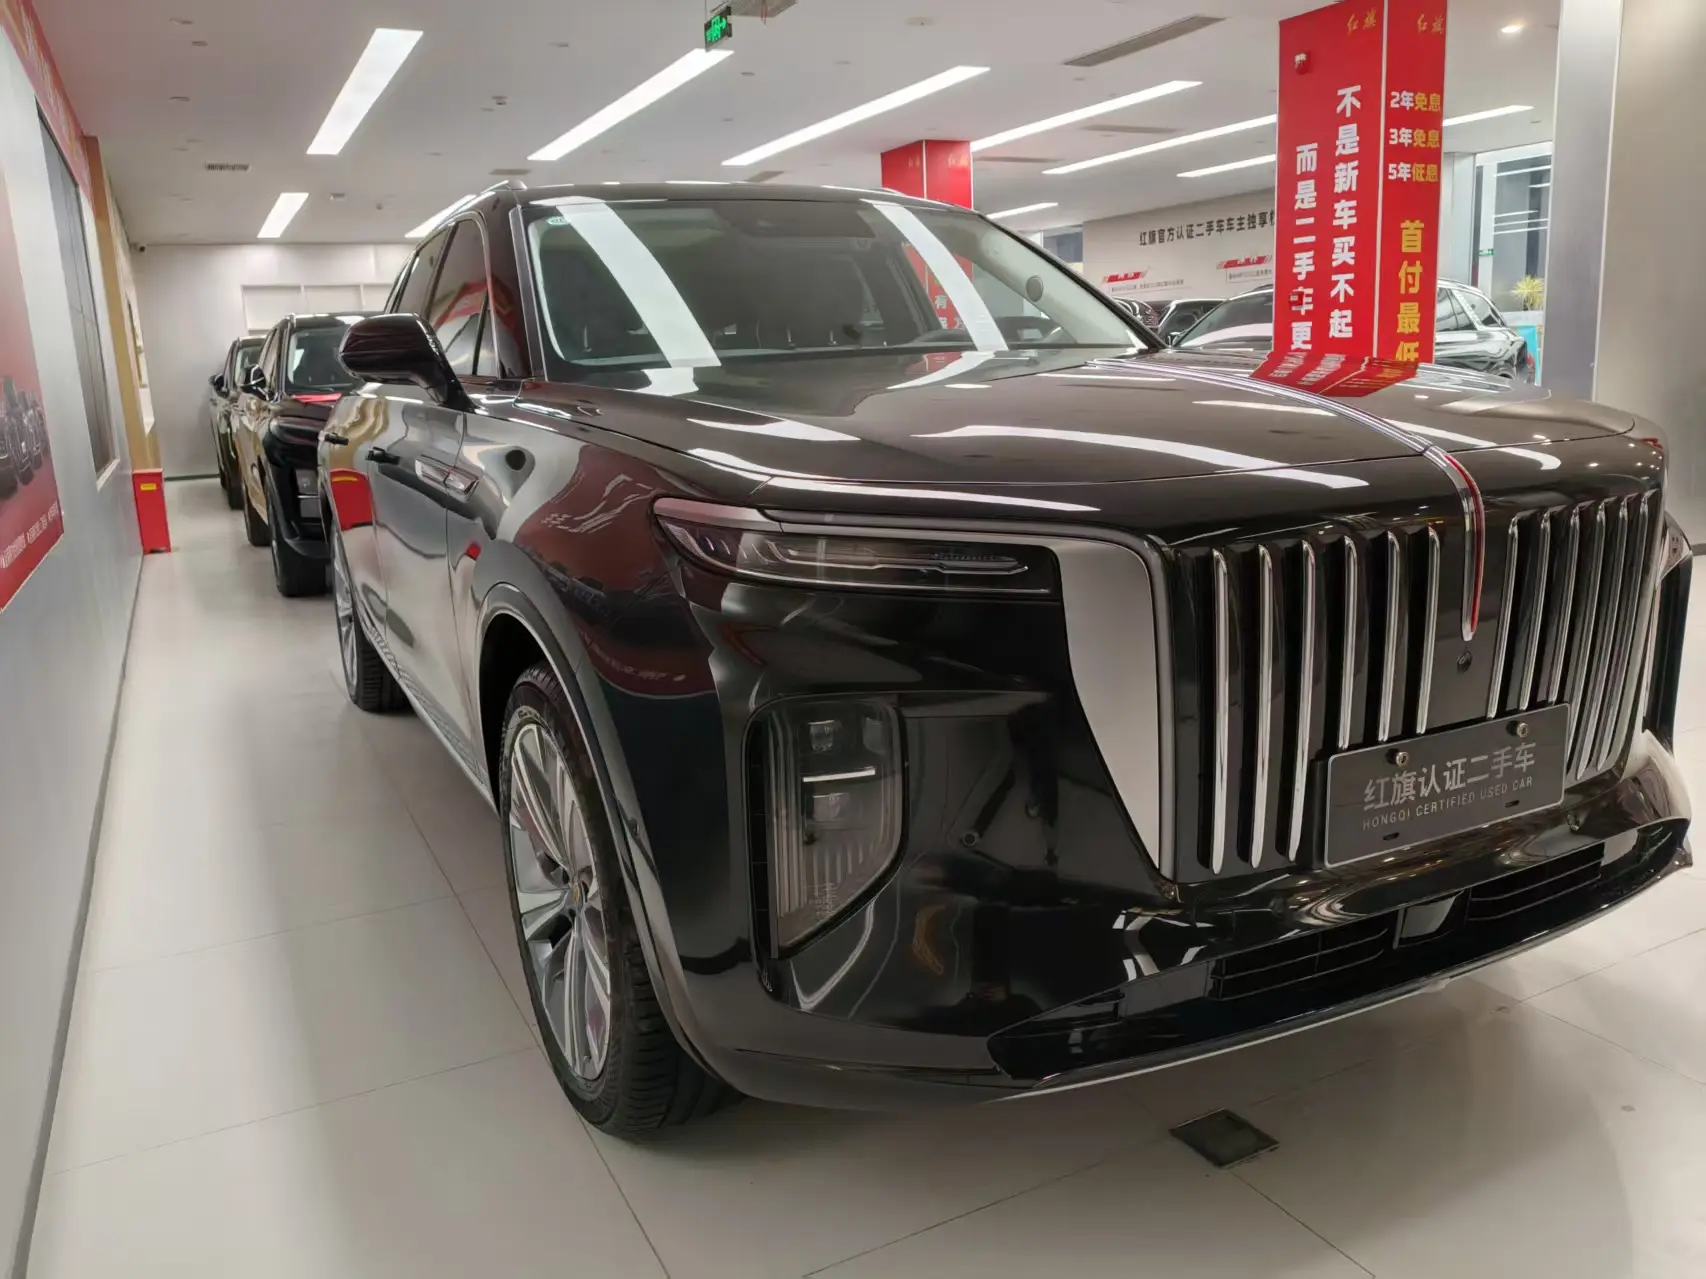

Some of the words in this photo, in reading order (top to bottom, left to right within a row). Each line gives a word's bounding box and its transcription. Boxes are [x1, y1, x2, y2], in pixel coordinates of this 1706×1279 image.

[1389, 90, 1441, 112] 2年免息
[1388, 127, 1440, 148] 3年免息
[1387, 162, 1439, 182] 5年低息
[1328, 84, 1362, 339] 不是新车买不起
[1363, 742, 1537, 811] 红旗认证二手车
[1362, 808, 1411, 831] HONGQI
[1416, 791, 1475, 817] CERTIFIED
[1480, 783, 1507, 801] USED
[1512, 776, 1533, 792] CAR
